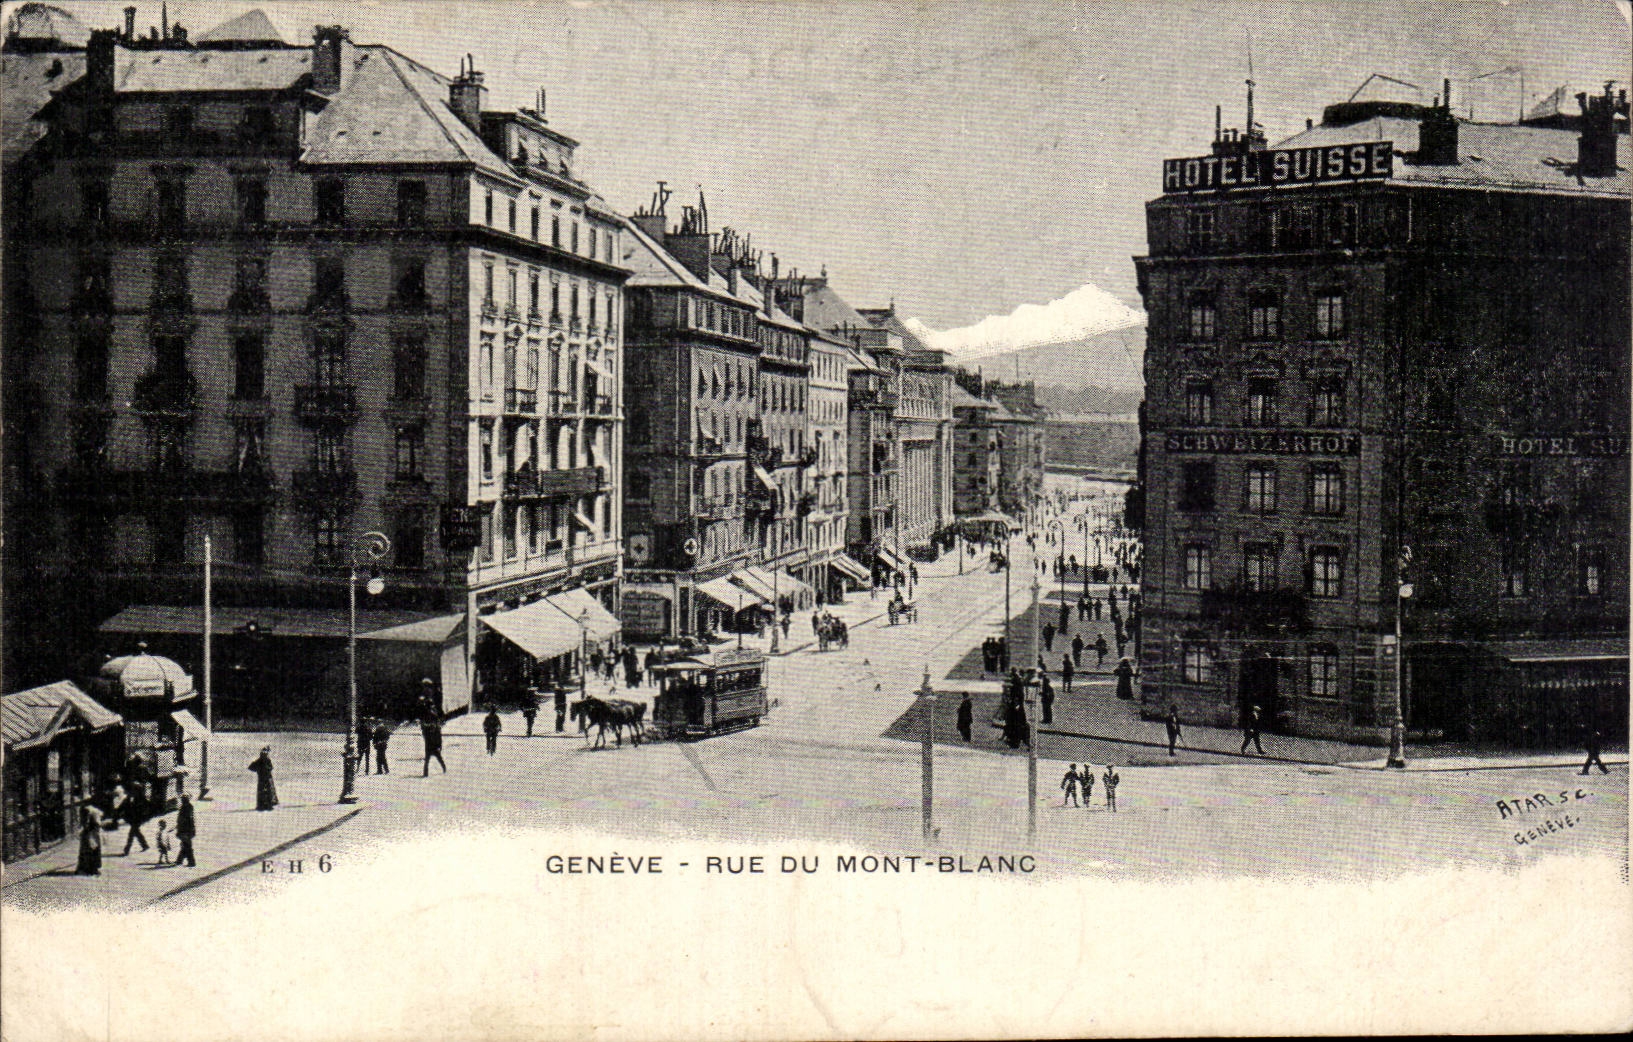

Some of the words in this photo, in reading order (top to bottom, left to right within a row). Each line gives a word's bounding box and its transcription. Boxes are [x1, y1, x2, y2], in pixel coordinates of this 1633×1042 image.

[1165, 156, 1257, 187] HOTEL
[1272, 145, 1389, 180] SUISSE
[1168, 434, 1355, 452] SCHWEIZERHOF
[1501, 436, 1577, 454] HOTEL
[1496, 793, 1554, 819] ATAR
